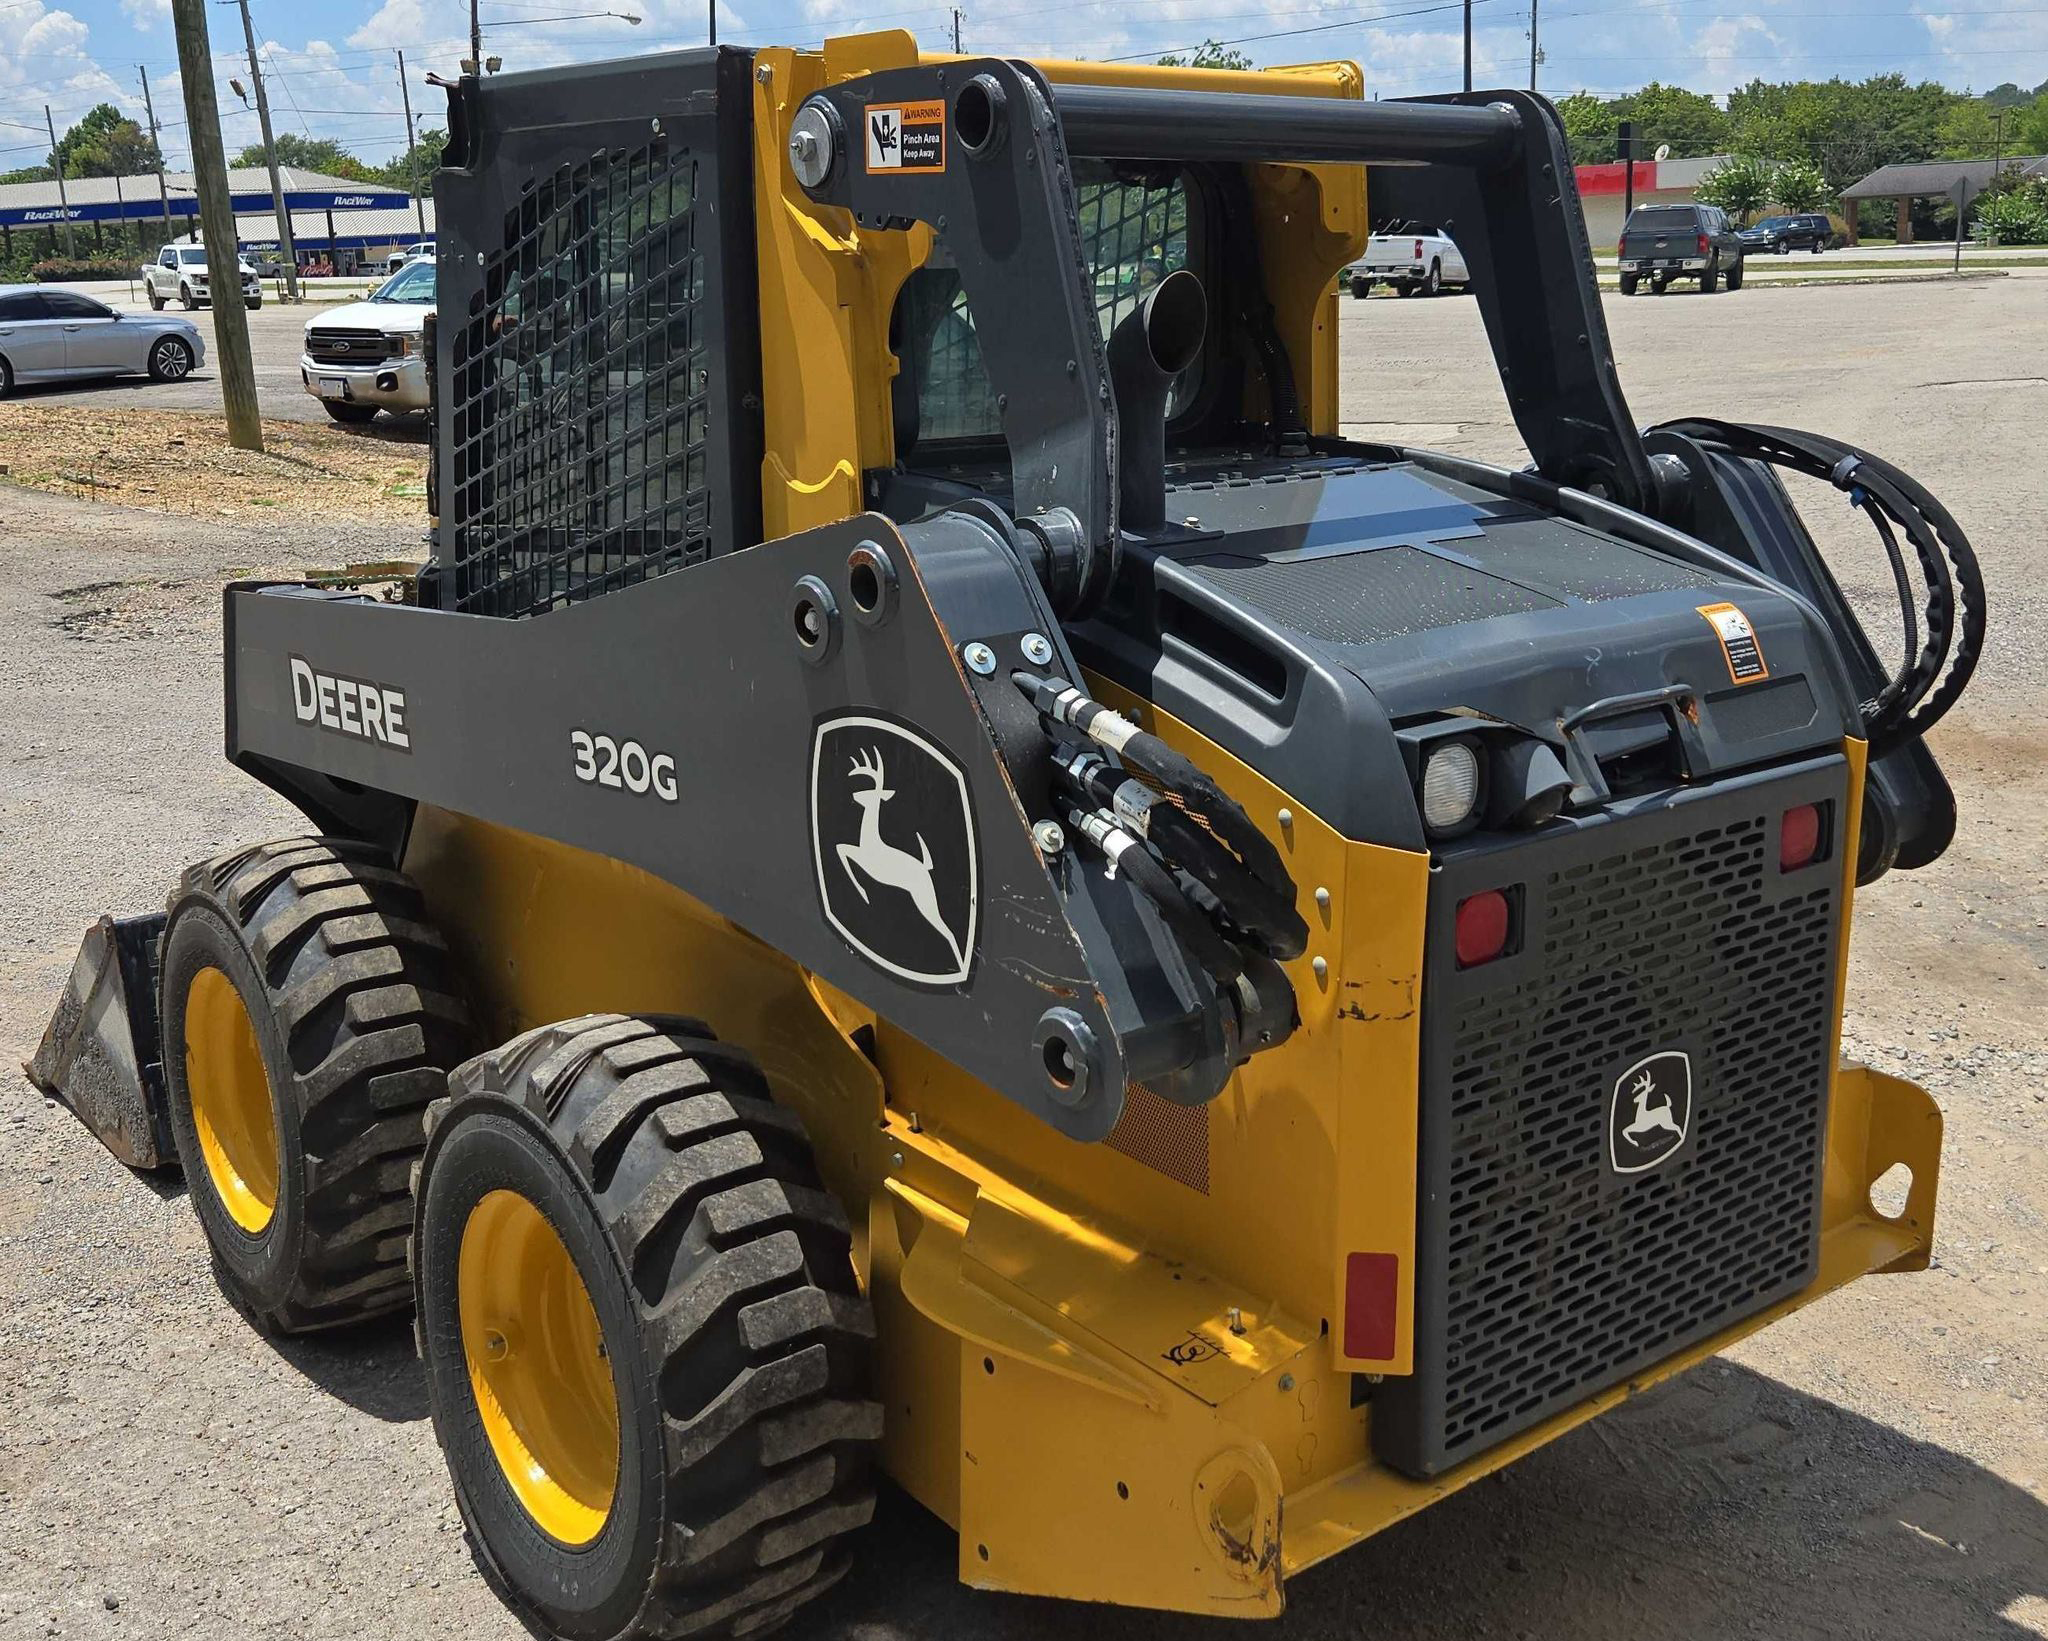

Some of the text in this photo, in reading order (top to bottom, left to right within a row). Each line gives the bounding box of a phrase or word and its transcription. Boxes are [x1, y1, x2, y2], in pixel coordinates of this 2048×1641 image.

[911, 108, 941, 119] WARNING
[903, 133, 940, 144] Pinch Area
[903, 148, 935, 160] Keep Away
[291, 658, 409, 748] DEERE
[571, 730, 678, 801] 320G
